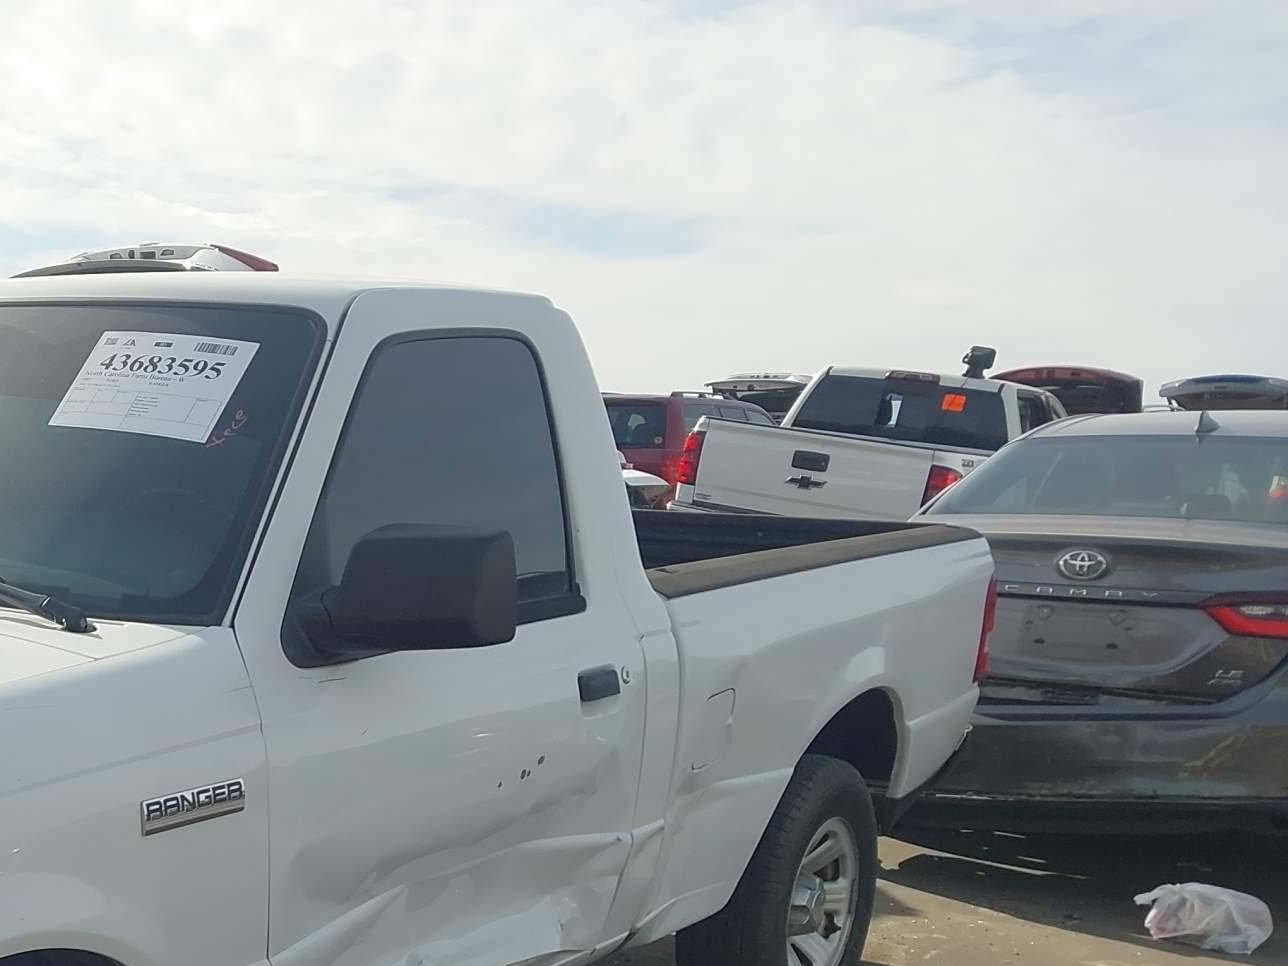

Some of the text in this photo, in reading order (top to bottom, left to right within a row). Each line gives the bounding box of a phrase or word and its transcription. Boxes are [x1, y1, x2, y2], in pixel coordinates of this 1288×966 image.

[99, 352, 227, 381] 43683595
[1004, 584, 1159, 598] CAMRY
[145, 780, 244, 822] RANGER
